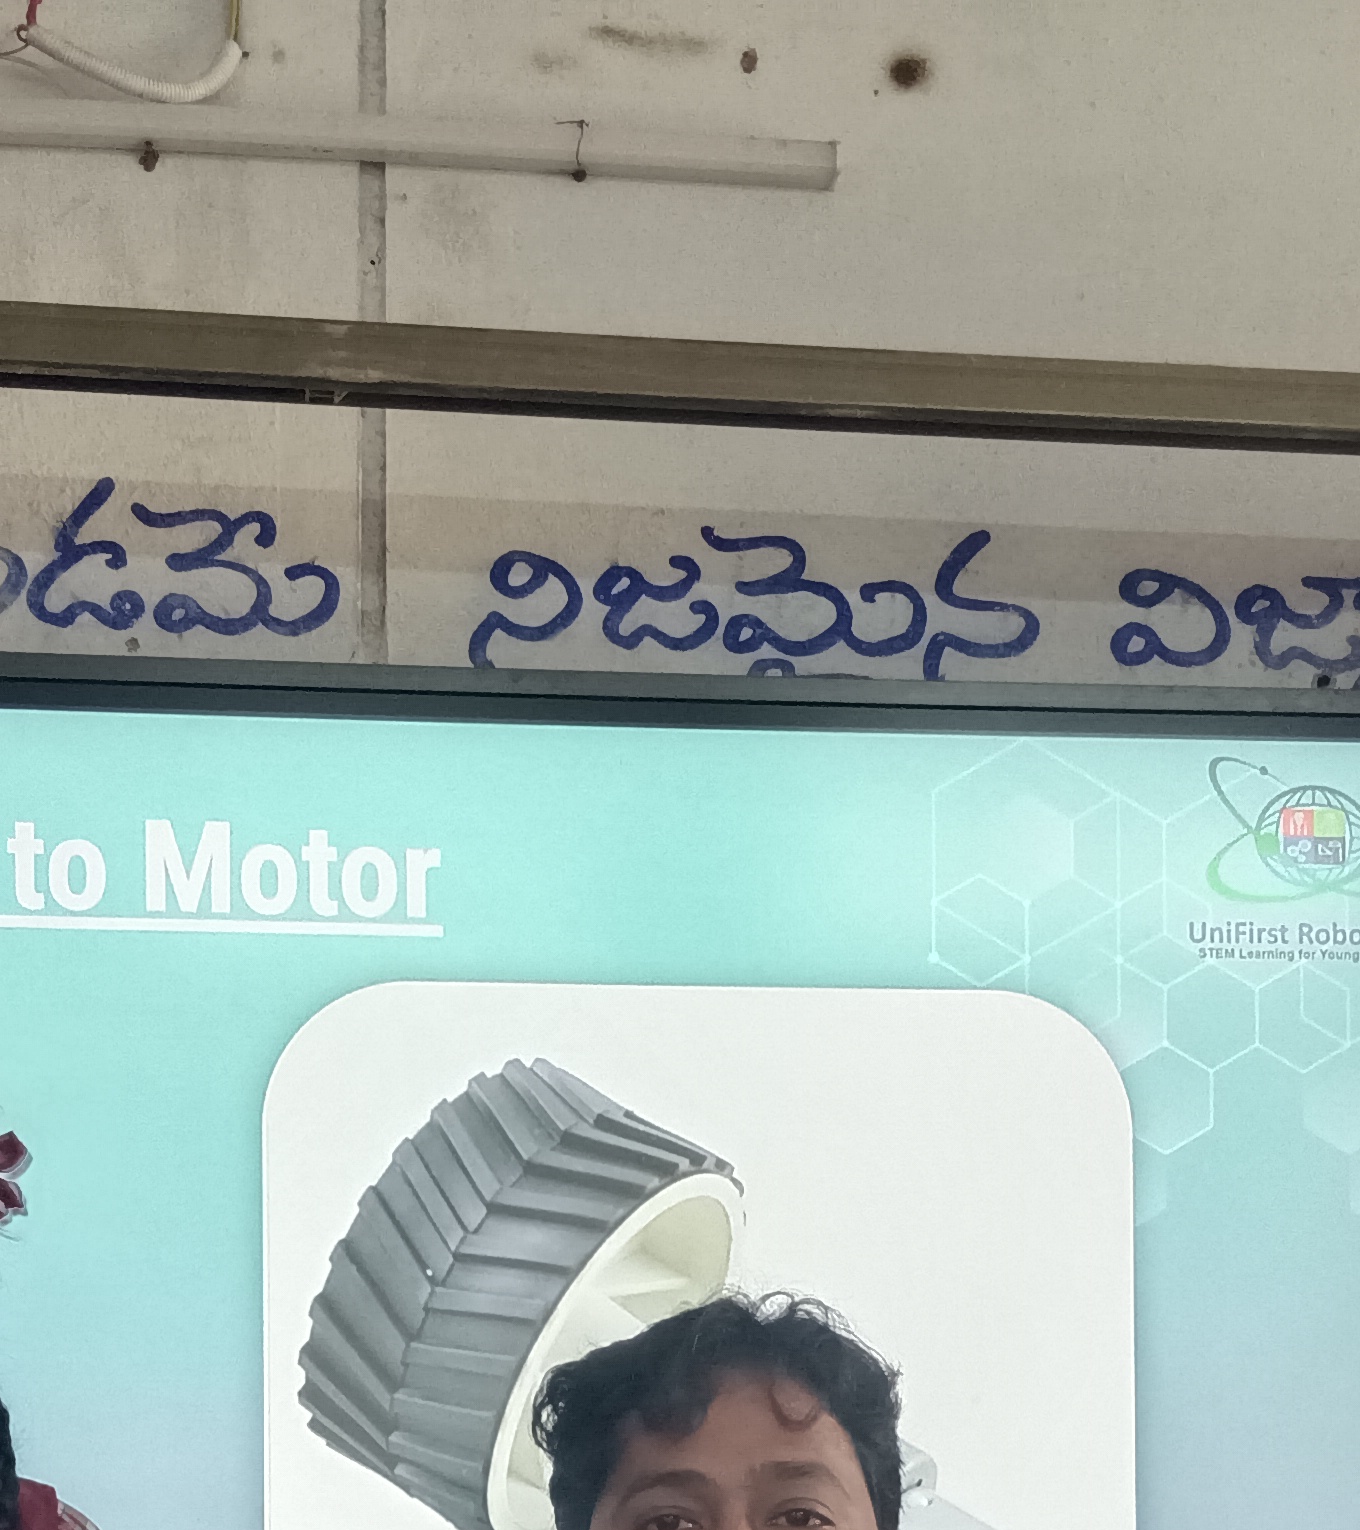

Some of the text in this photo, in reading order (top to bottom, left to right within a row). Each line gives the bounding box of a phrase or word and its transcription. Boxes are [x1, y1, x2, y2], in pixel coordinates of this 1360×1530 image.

[6, 820, 107, 912] to
[144, 818, 442, 920] Motor
[1188, 920, 1290, 945] UniFirst
[1197, 947, 1236, 960] STEM
[1239, 947, 1295, 963] Learning
[1297, 948, 1317, 961] for
[1320, 948, 1360, 964] Young
